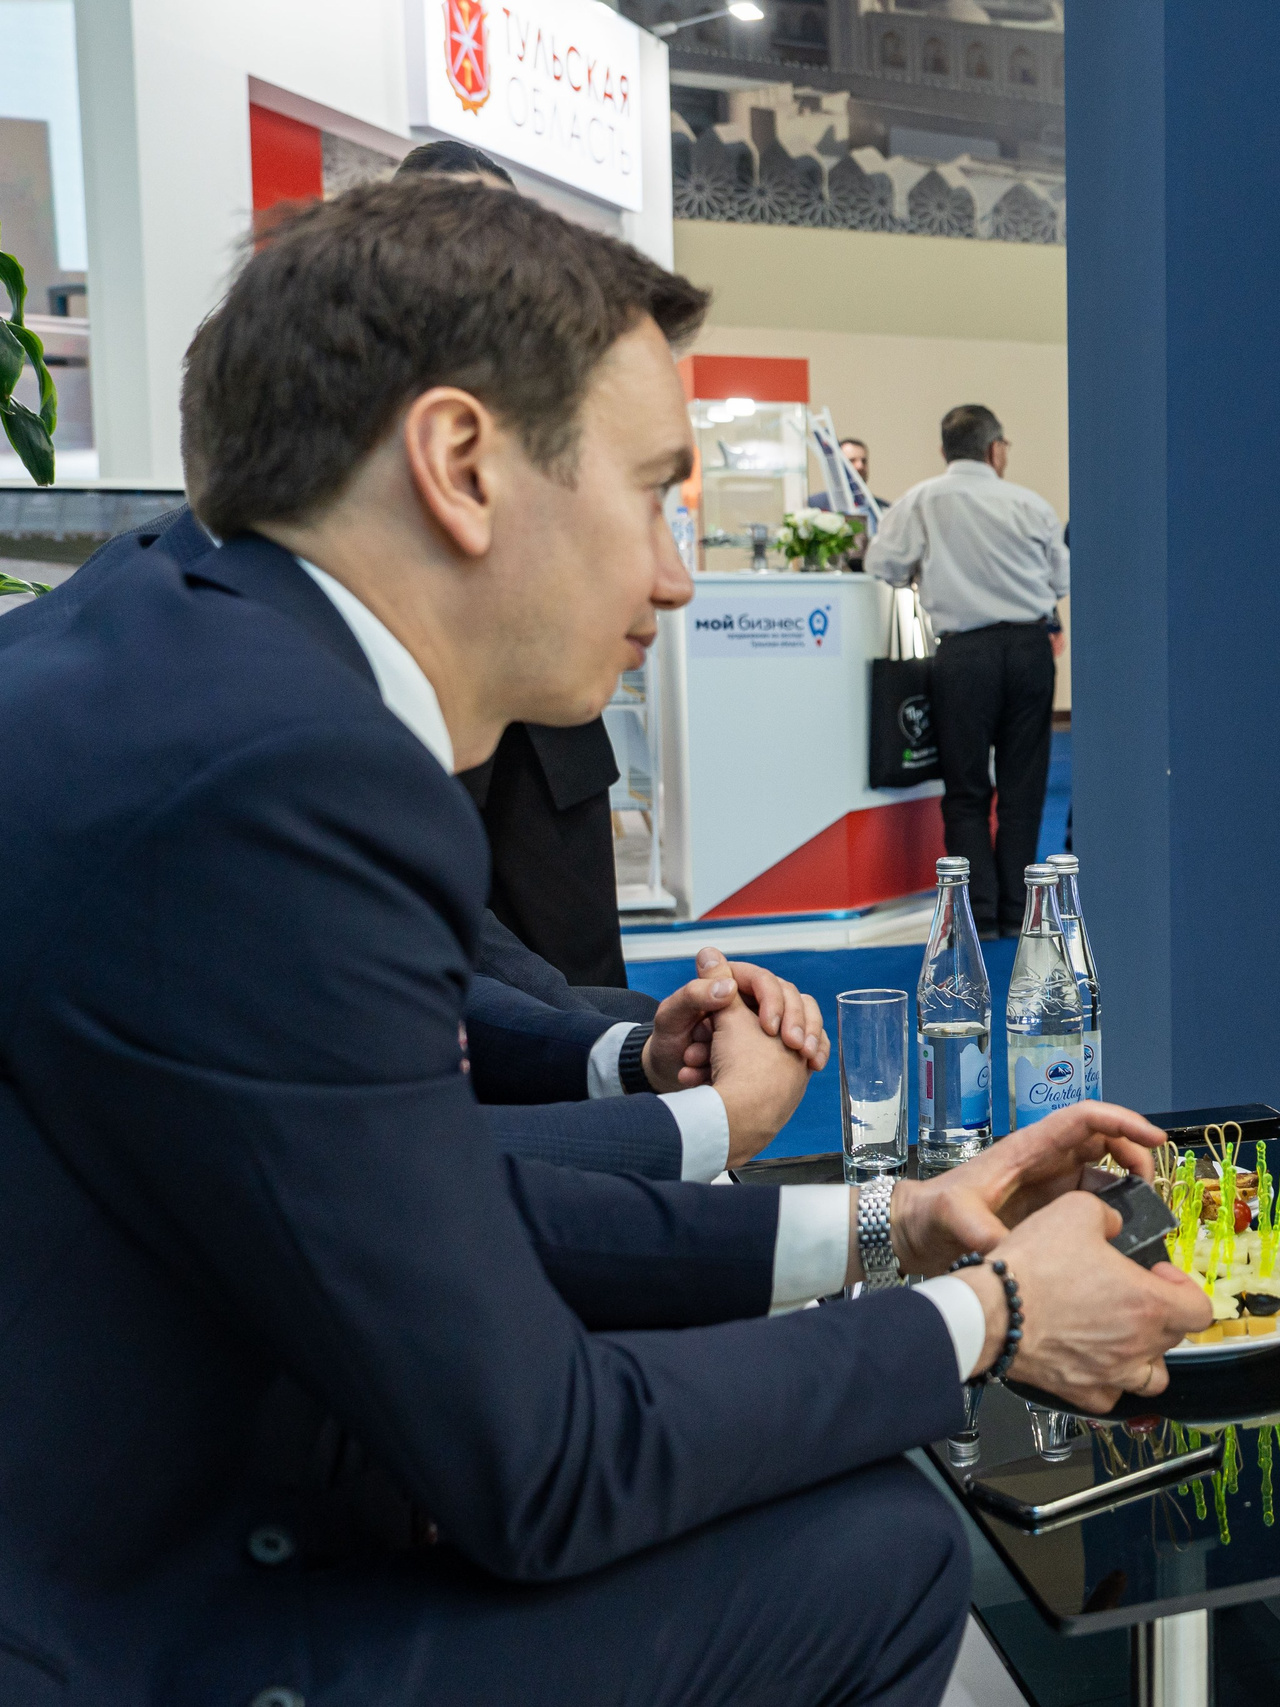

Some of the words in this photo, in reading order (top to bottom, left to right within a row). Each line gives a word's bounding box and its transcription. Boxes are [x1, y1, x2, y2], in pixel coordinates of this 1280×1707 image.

[502, 7, 631, 118] ТУЛЬСКАЯ
[507, 76, 632, 176] ОБЛАСТЬ
[696, 614, 735, 631] мой
[738, 612, 805, 631] бизнес
